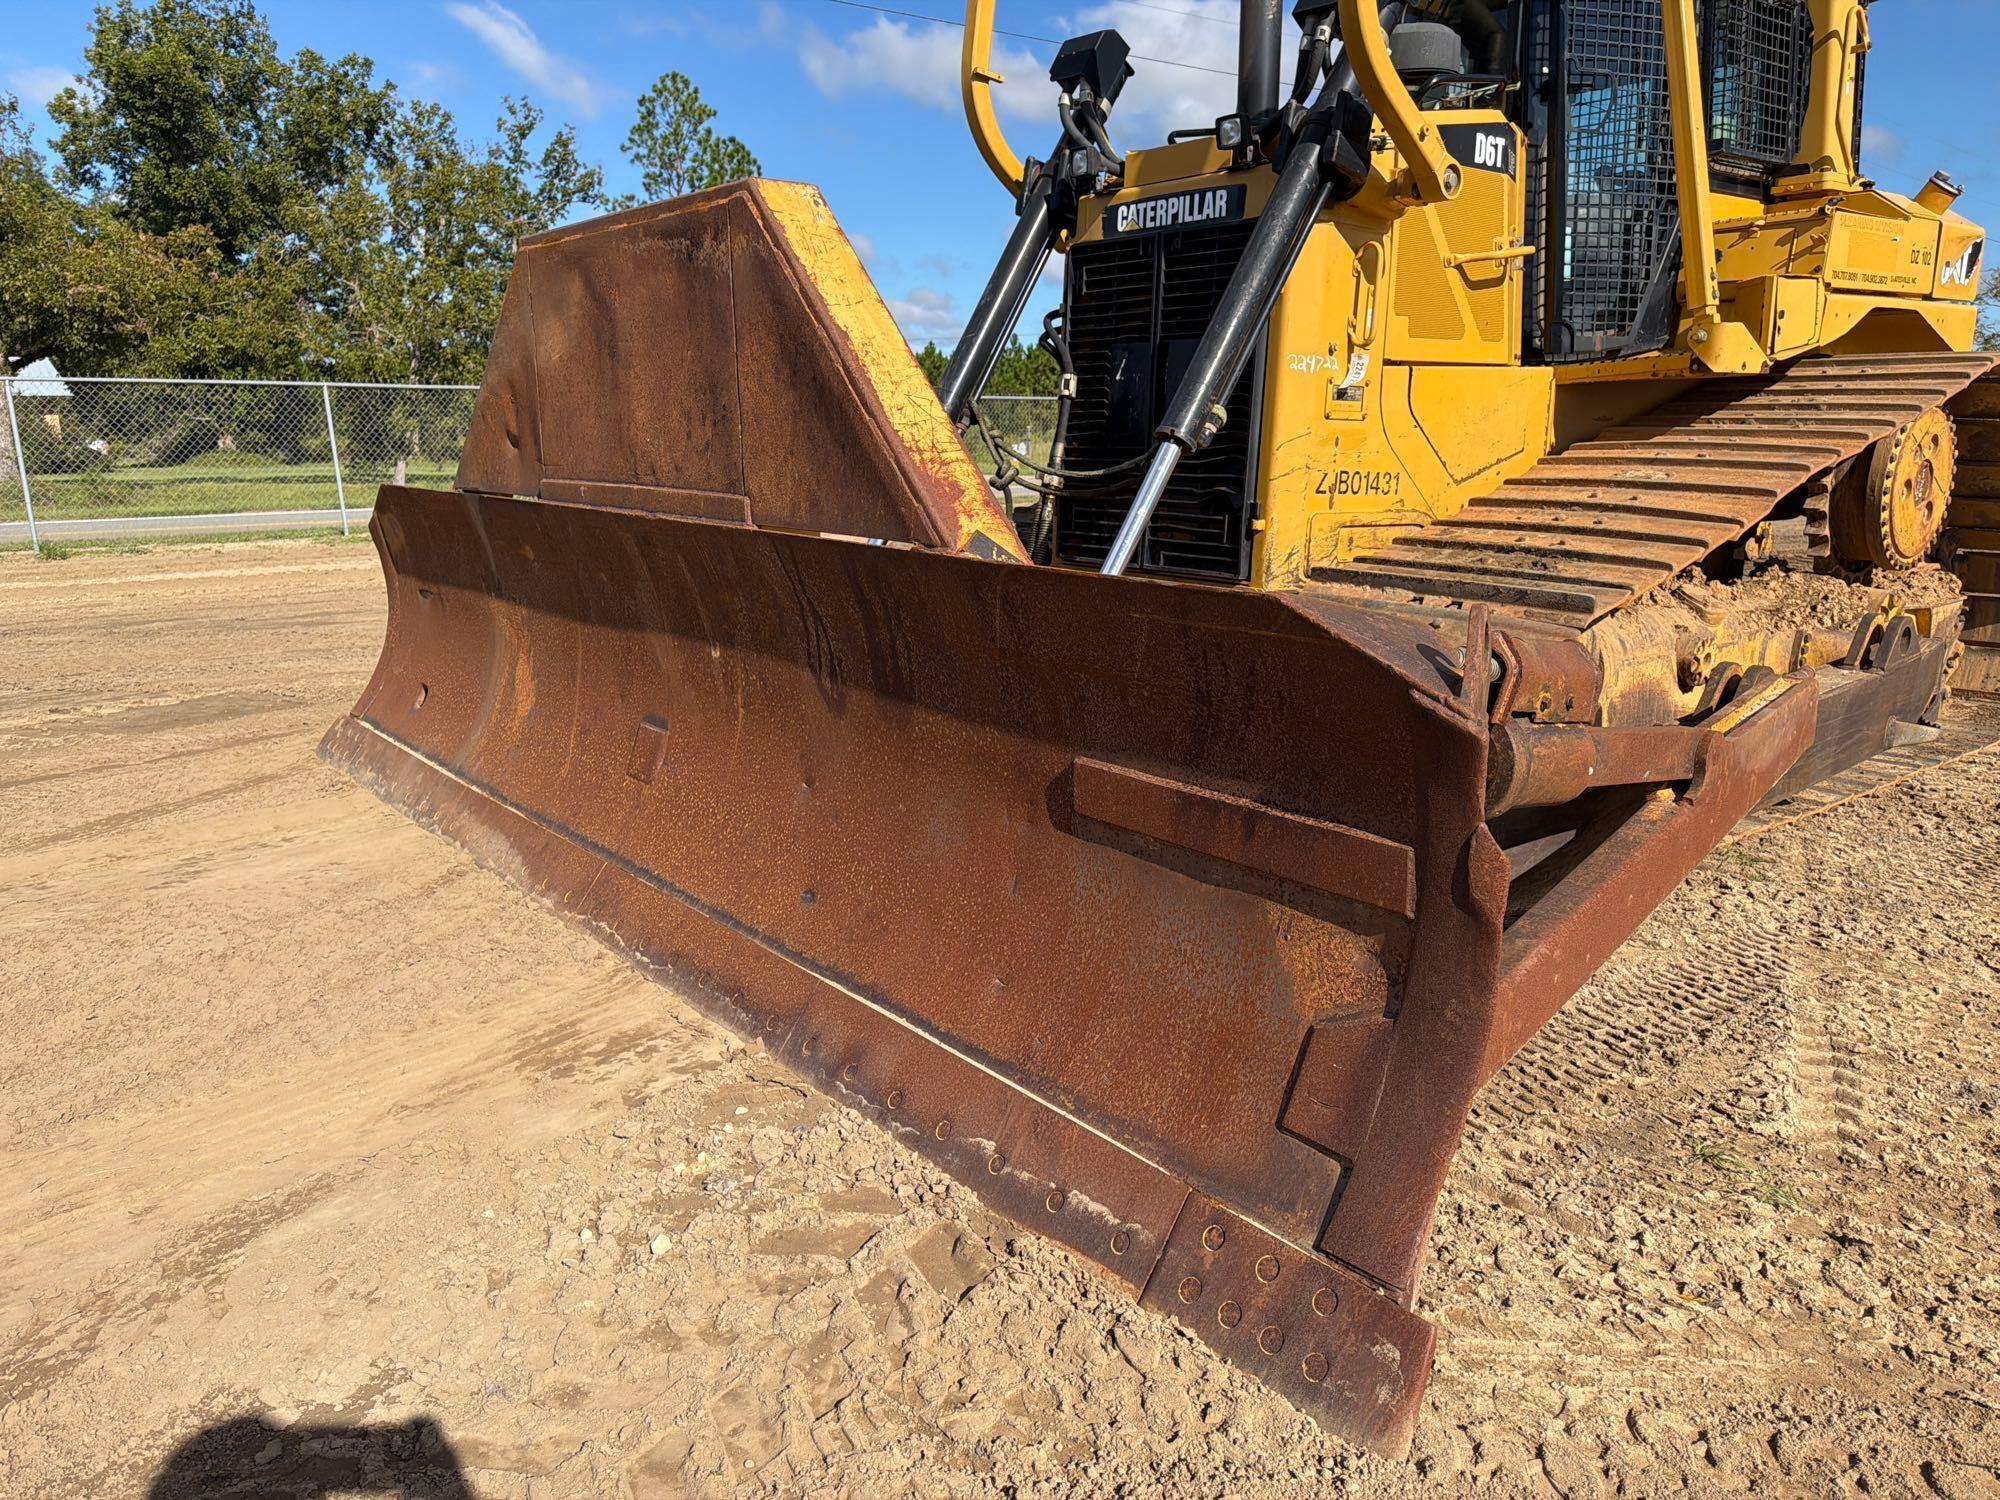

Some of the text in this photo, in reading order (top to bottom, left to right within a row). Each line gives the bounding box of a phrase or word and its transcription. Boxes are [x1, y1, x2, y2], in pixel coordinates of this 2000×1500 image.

[1474, 132, 1506, 168] D6T
[1116, 189, 1228, 233] CATERPILLAR
[1910, 249, 1932, 266] DZ 102
[1287, 353, 1339, 374] 224722
[1315, 470, 1400, 496] ZJB01431
